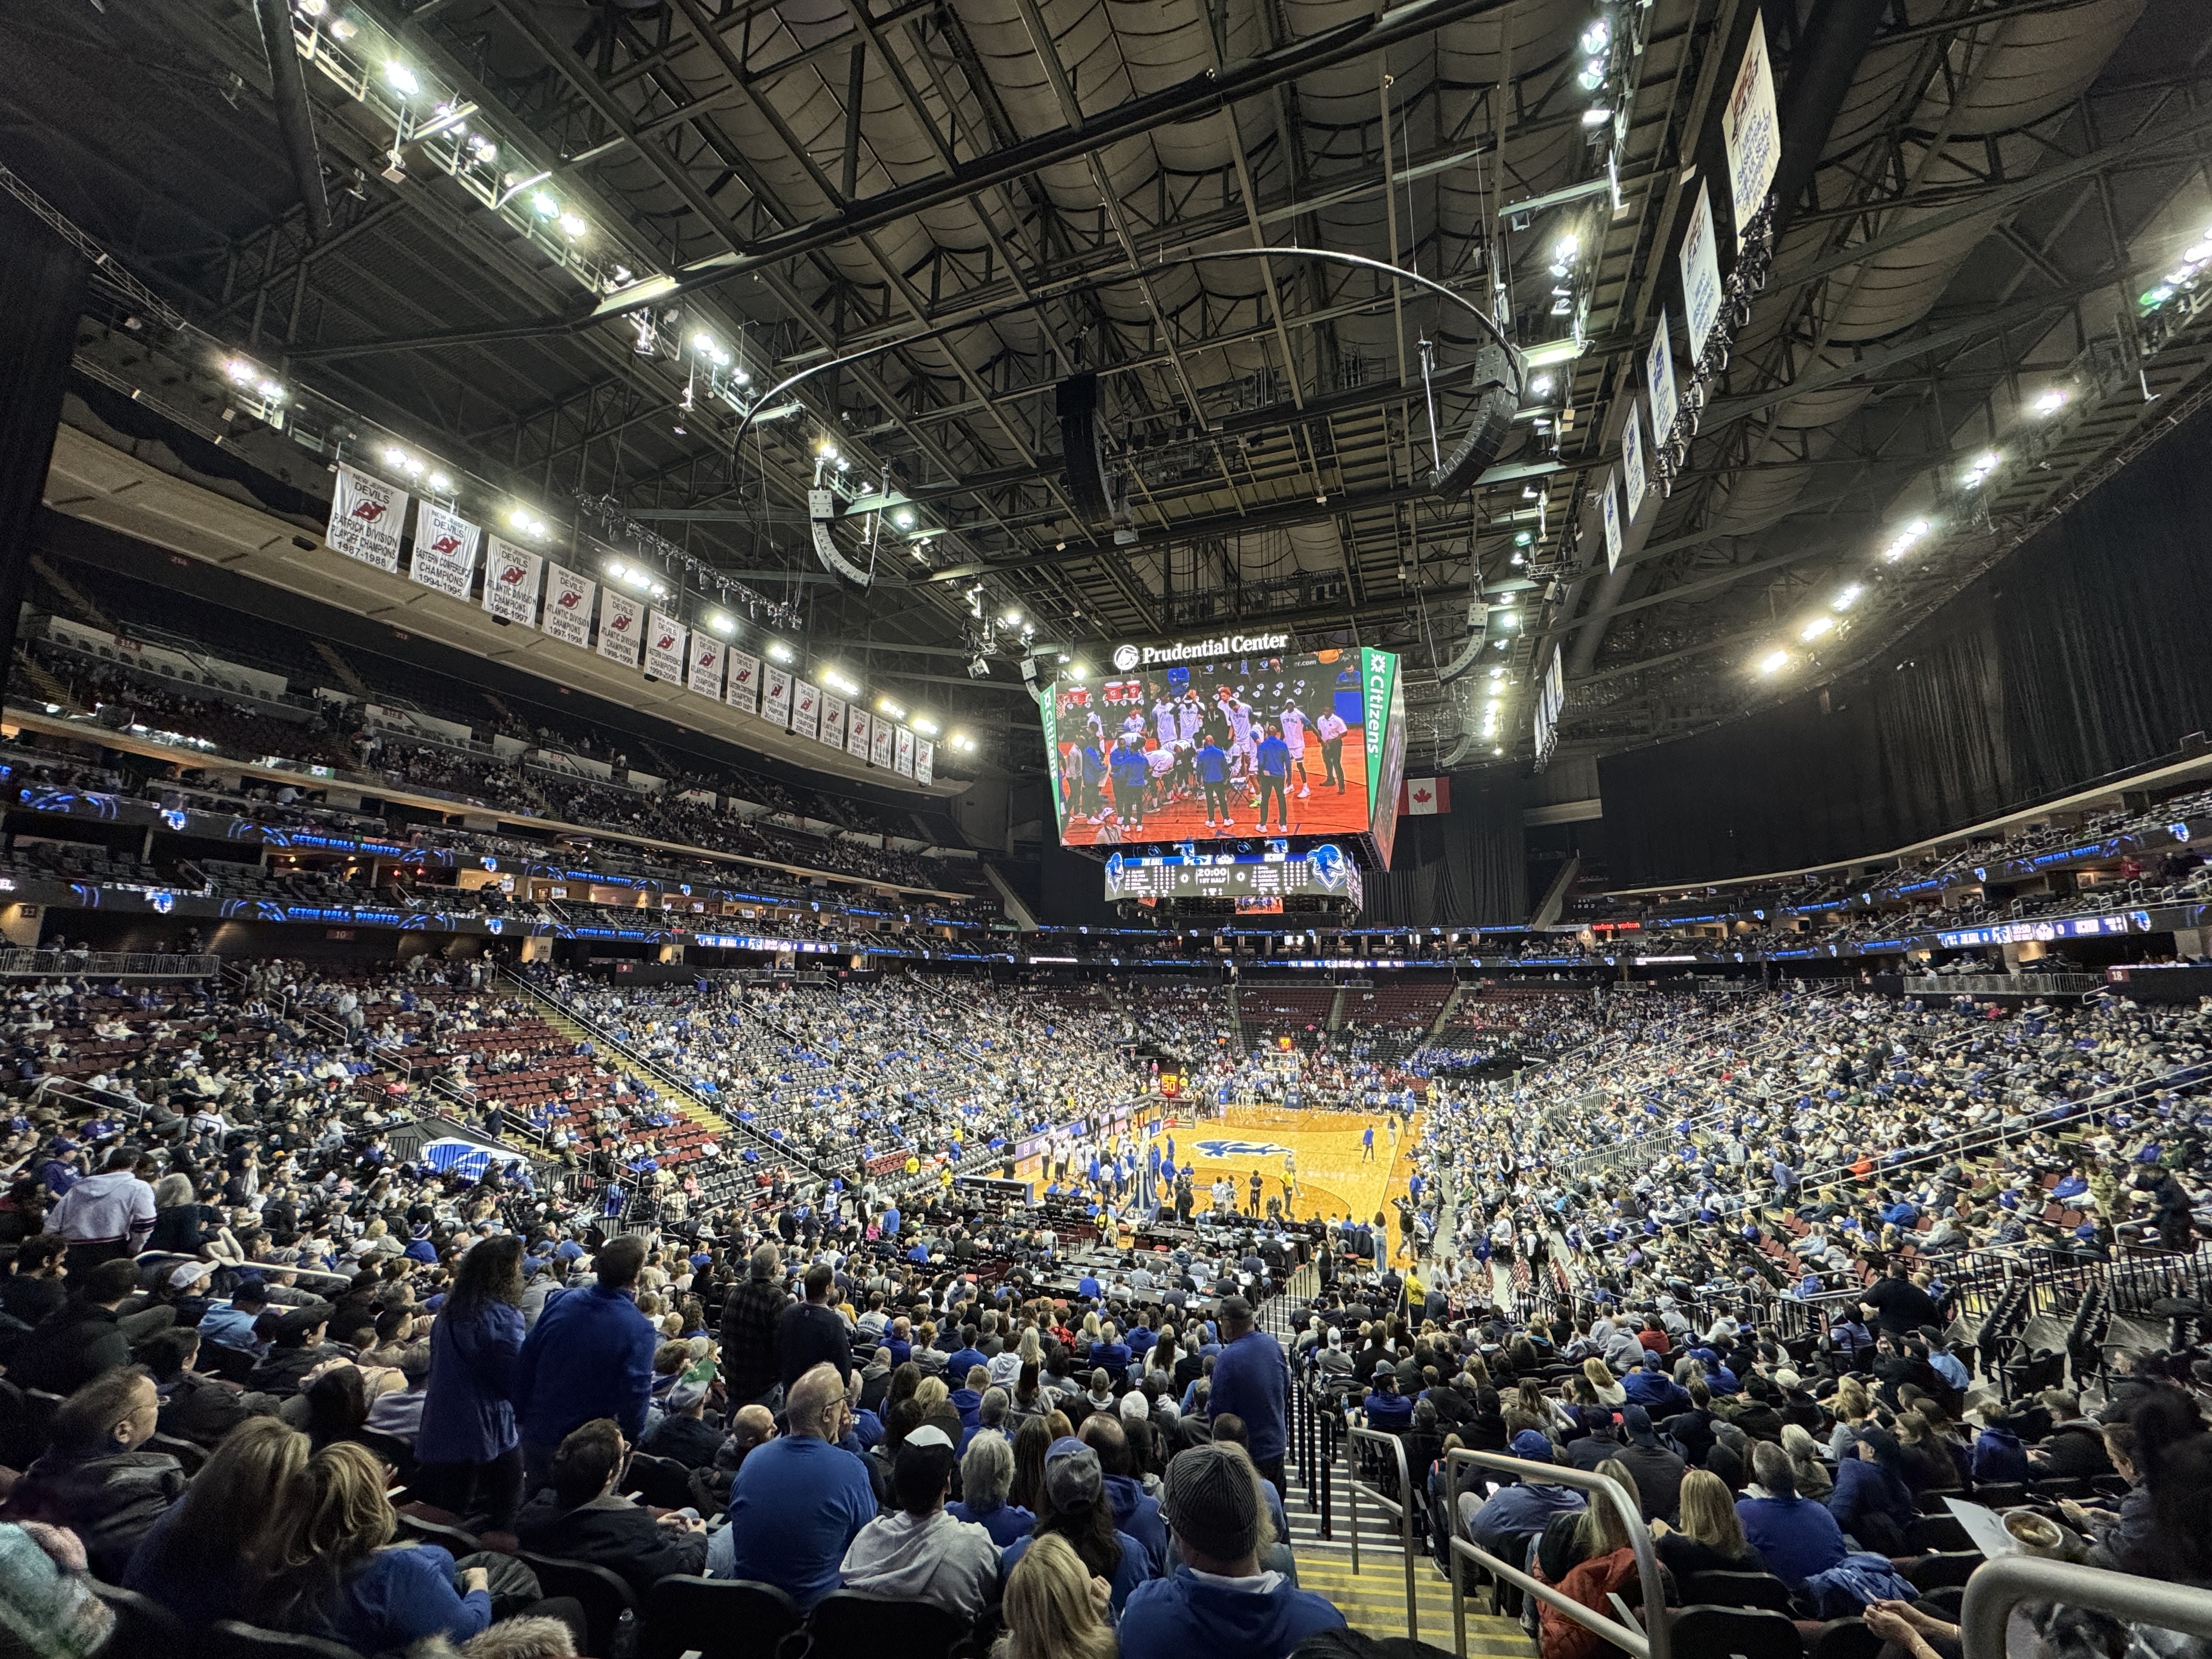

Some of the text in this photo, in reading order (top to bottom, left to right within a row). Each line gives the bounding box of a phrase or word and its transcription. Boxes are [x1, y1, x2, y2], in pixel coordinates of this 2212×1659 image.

[1733, 50, 1754, 119] BIG
[1730, 48, 1762, 145] EAST
[353, 473, 394, 495] NEW JERSEY
[354, 482, 390, 504] DEVILS
[432, 510, 468, 529] NEW JERSEY
[335, 512, 398, 548] PATRICK DIVISION
[434, 519, 464, 538] DEVILS
[331, 525, 396, 559] PLAYOFF CHAMPIONS
[338, 541, 386, 567] 1987-1988
[416, 547, 438, 563] EASTERN
[501, 551, 528, 568] DEVILS
[513, 549, 532, 561] JERSEY
[420, 562, 464, 587] CHAMPIONS
[558, 570, 586, 586] NEW JERSEY
[419, 574, 462, 596] 1994-1995
[486, 579, 536, 606] ATLANTIC DIVISION
[560, 577, 584, 593] DEVILS
[494, 594, 526, 613] CHAMPIONS
[612, 601, 633, 616] DEVILS
[490, 603, 528, 623] 1996-1997
[546, 603, 589, 628] ATLANTIC DIVISION
[553, 617, 580, 635] CHAMPIONS
[658, 622, 677, 636] DEVILS
[550, 627, 583, 644] 1997-1998
[601, 627, 639, 648] ATLANTIC DIVISION
[607, 639, 631, 656] CHAMPIONS
[699, 641, 716, 653] DEVILS
[1142, 634, 1288, 664] Prudential Center
[604, 648, 633, 664] 1998-1999
[737, 658, 752, 669] DEVILS
[650, 666, 676, 681] 1999-2000
[651, 657, 677, 675] CHAMPIONS
[771, 675, 785, 685] DEVILS
[1367, 675, 1385, 754] Citizens
[1046, 710, 1058, 779] Citizens
[1150, 857, 1164, 866] HALL
[1180, 873, 1189, 883] 0
[1198, 867, 1227, 877] 20:00
[1237, 872, 1245, 882] 0
[335, 931, 346, 939] 10
[2058, 924, 2065, 935] 0
[2112, 971, 2123, 981] 18
[1163, 1081, 1176, 1092] 30
